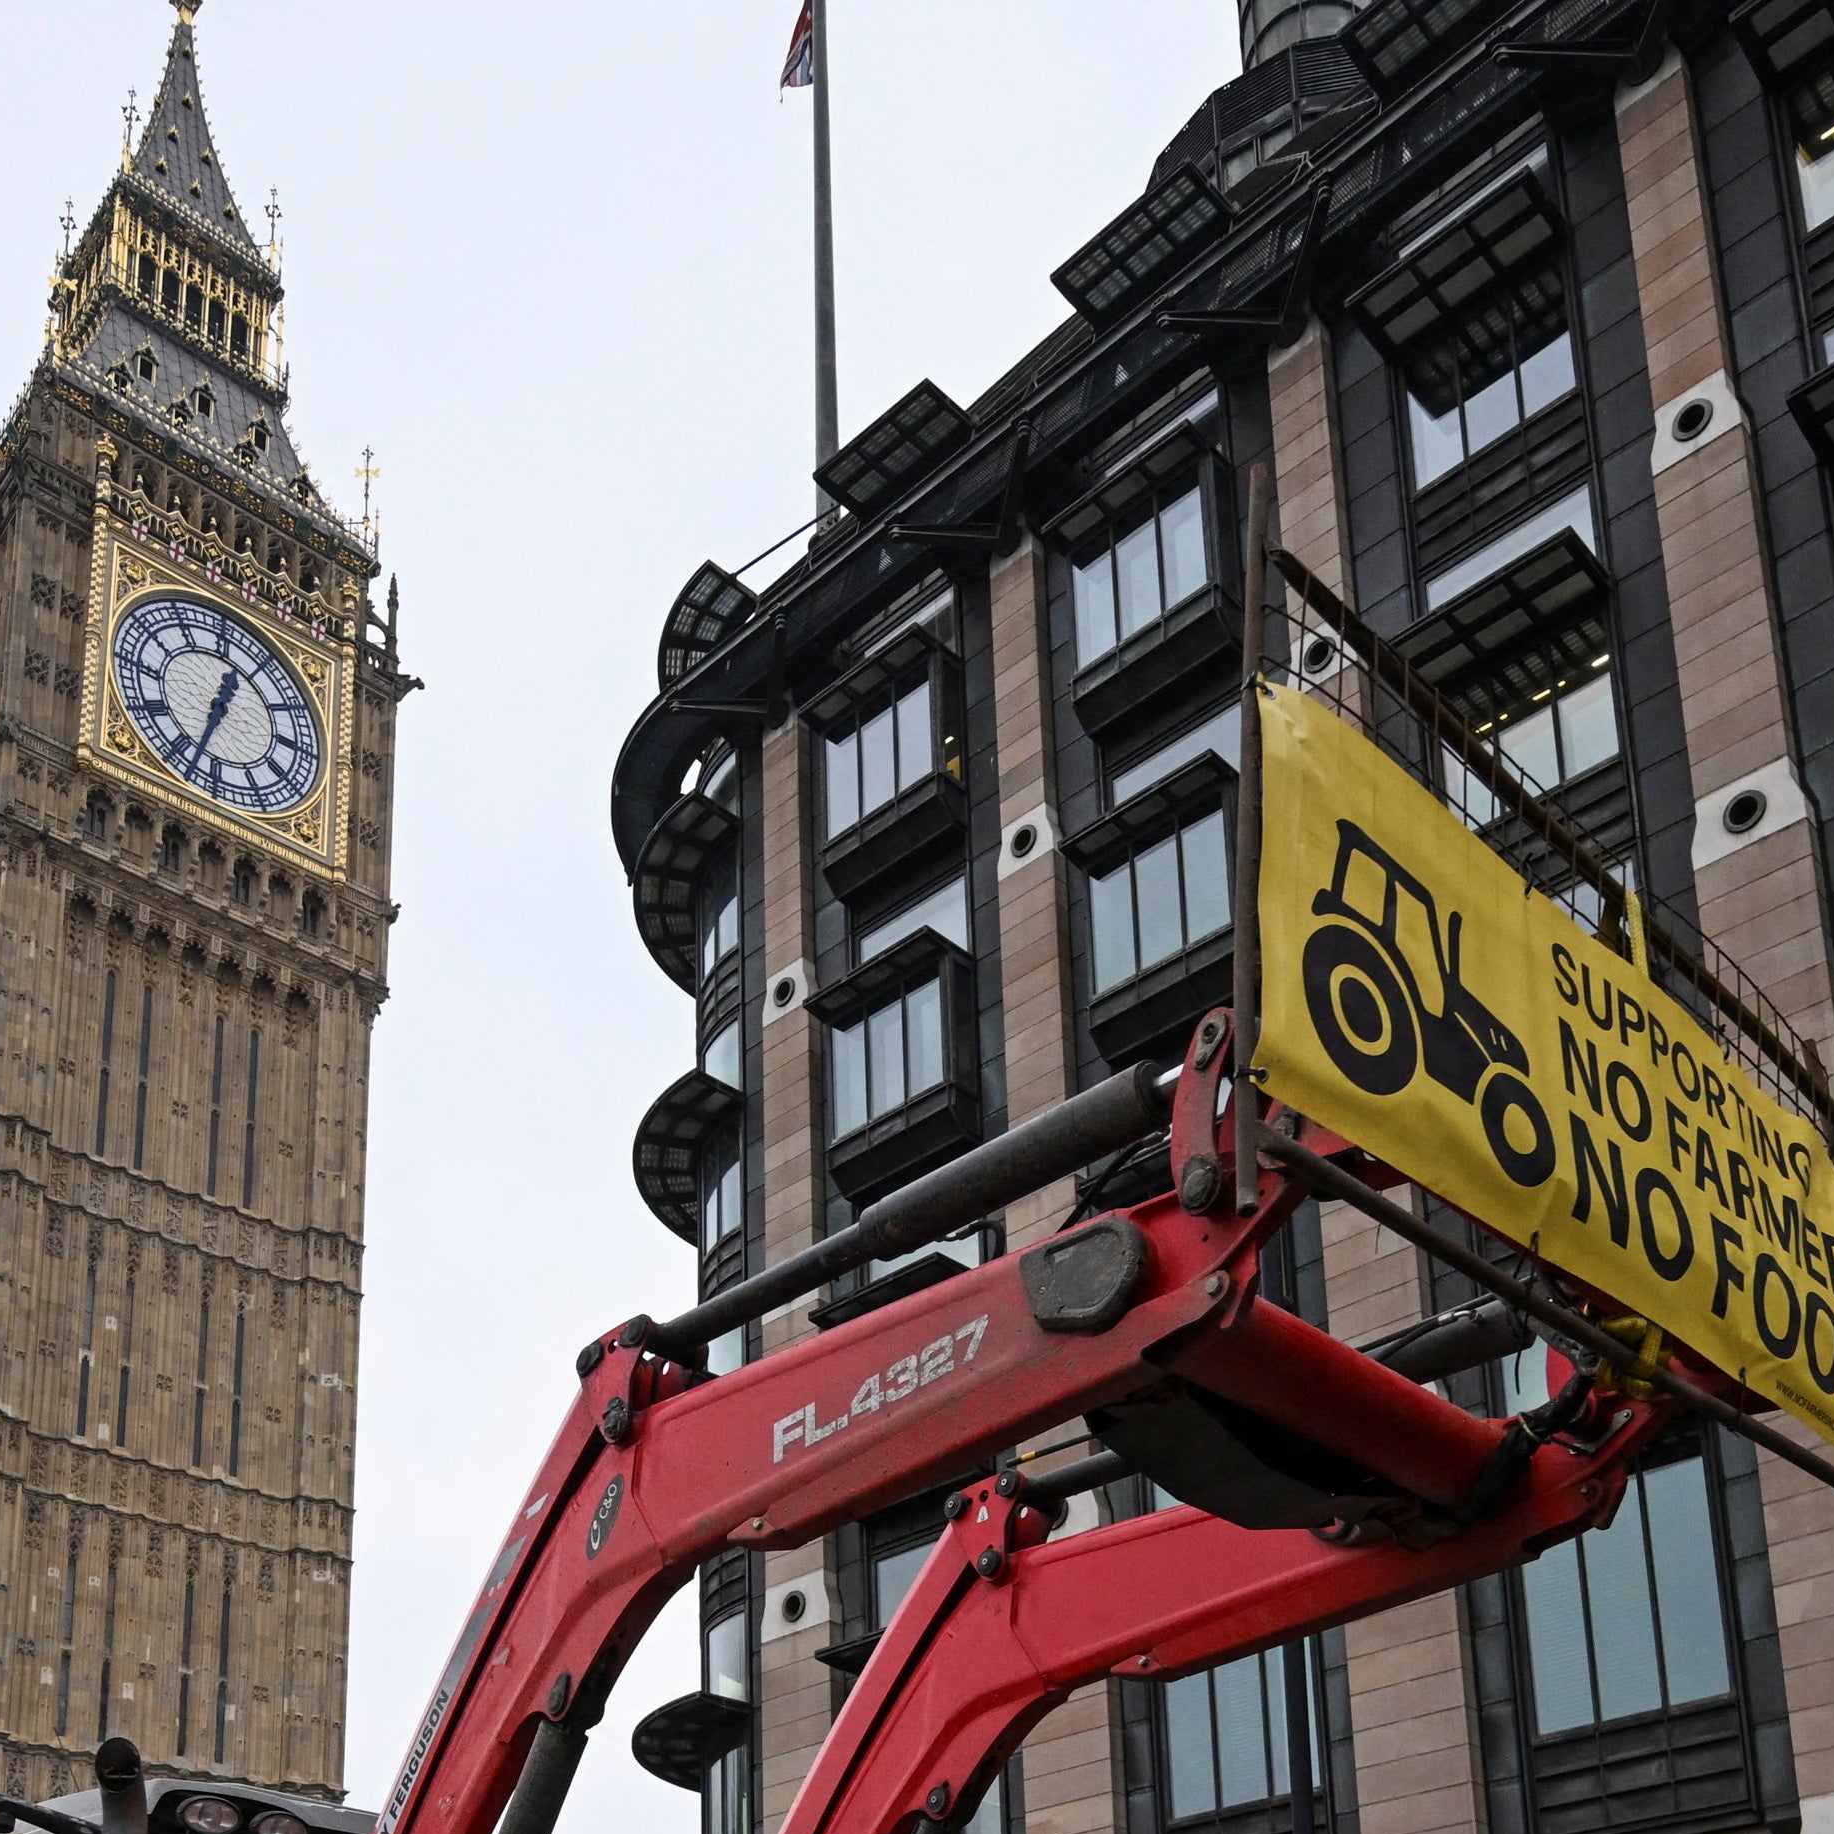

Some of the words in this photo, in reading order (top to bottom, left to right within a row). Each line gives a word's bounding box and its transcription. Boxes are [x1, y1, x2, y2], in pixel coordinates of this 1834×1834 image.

[1552, 943, 1811, 1197] SUPPORTING
[1558, 1015, 1652, 1142] NO
[1569, 1109, 1695, 1282] NO
[773, 1314, 989, 1464] FL.4327
[389, 1688, 450, 1820] FERGUSON
